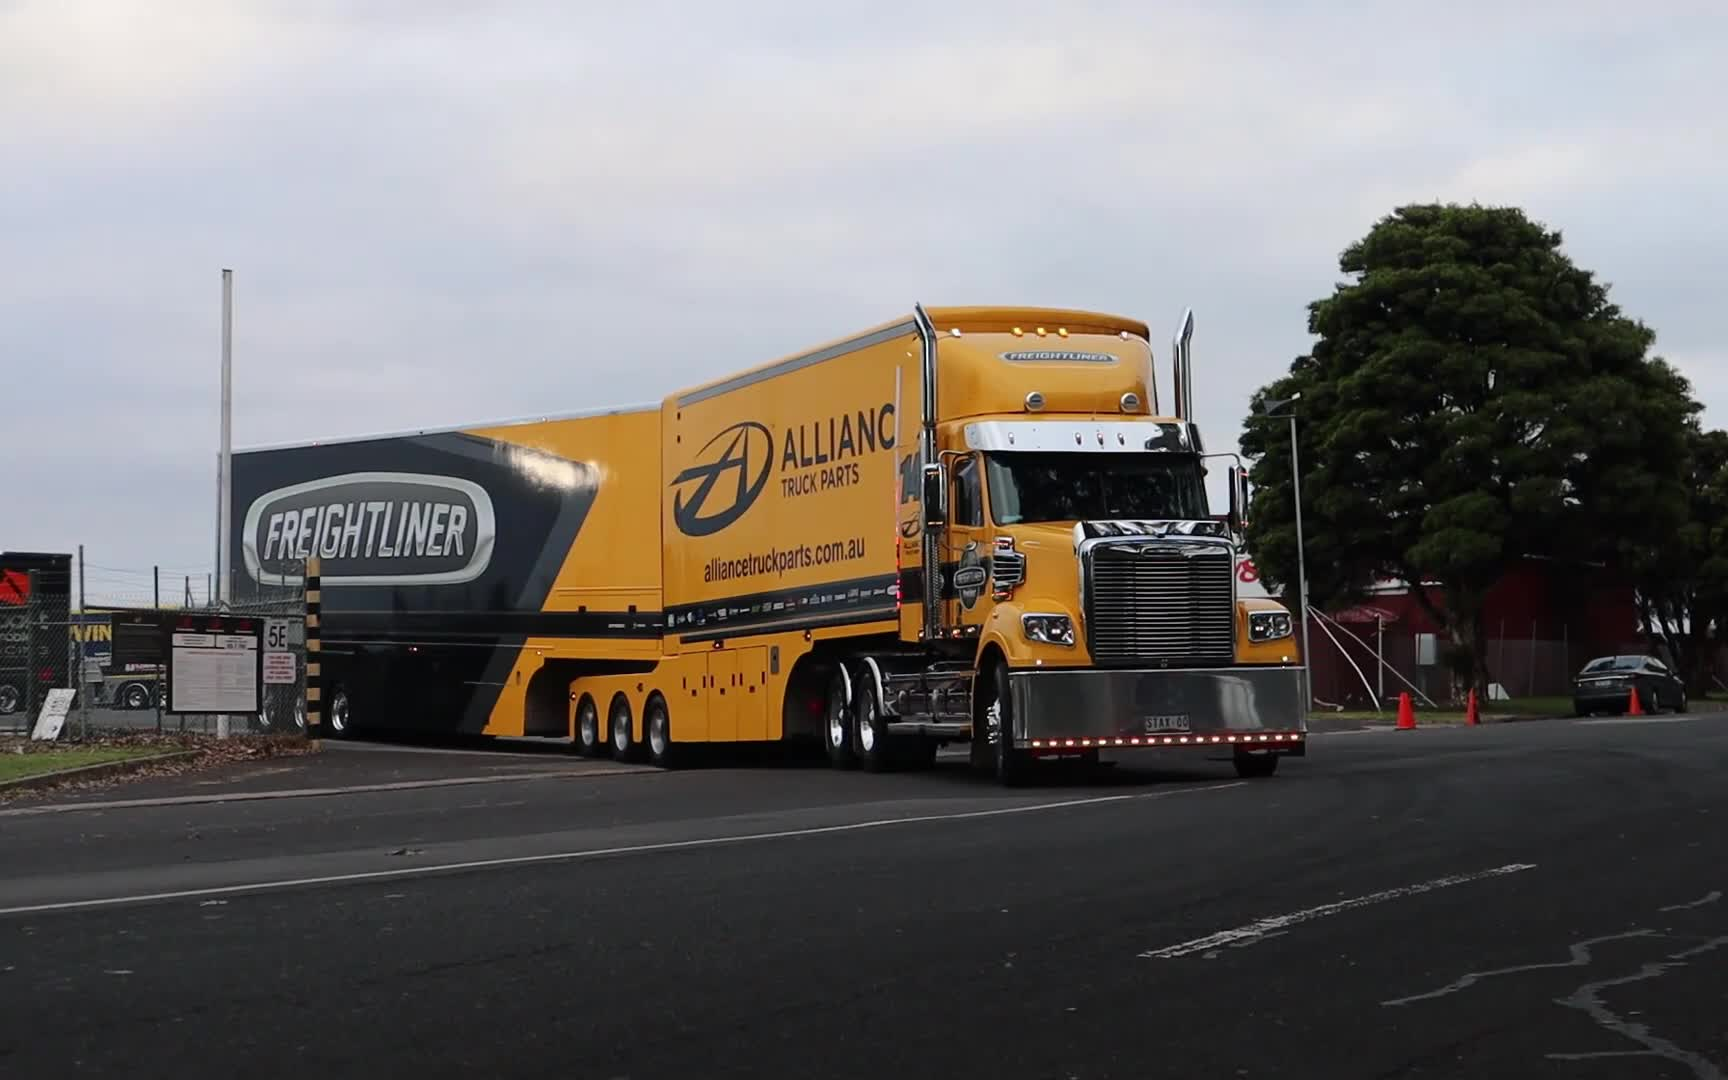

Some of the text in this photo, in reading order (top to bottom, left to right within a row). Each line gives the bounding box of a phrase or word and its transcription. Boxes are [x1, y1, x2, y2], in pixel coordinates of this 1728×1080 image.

[1009, 351, 1108, 361] FREIGHTLINER
[781, 403, 896, 472] ALLIANC
[781, 463, 860, 498] TRUCK PARTS
[263, 501, 468, 561] FREIGHTLINER
[704, 537, 865, 583] alliancetruckparts.com.au
[268, 625, 287, 648] 5E
